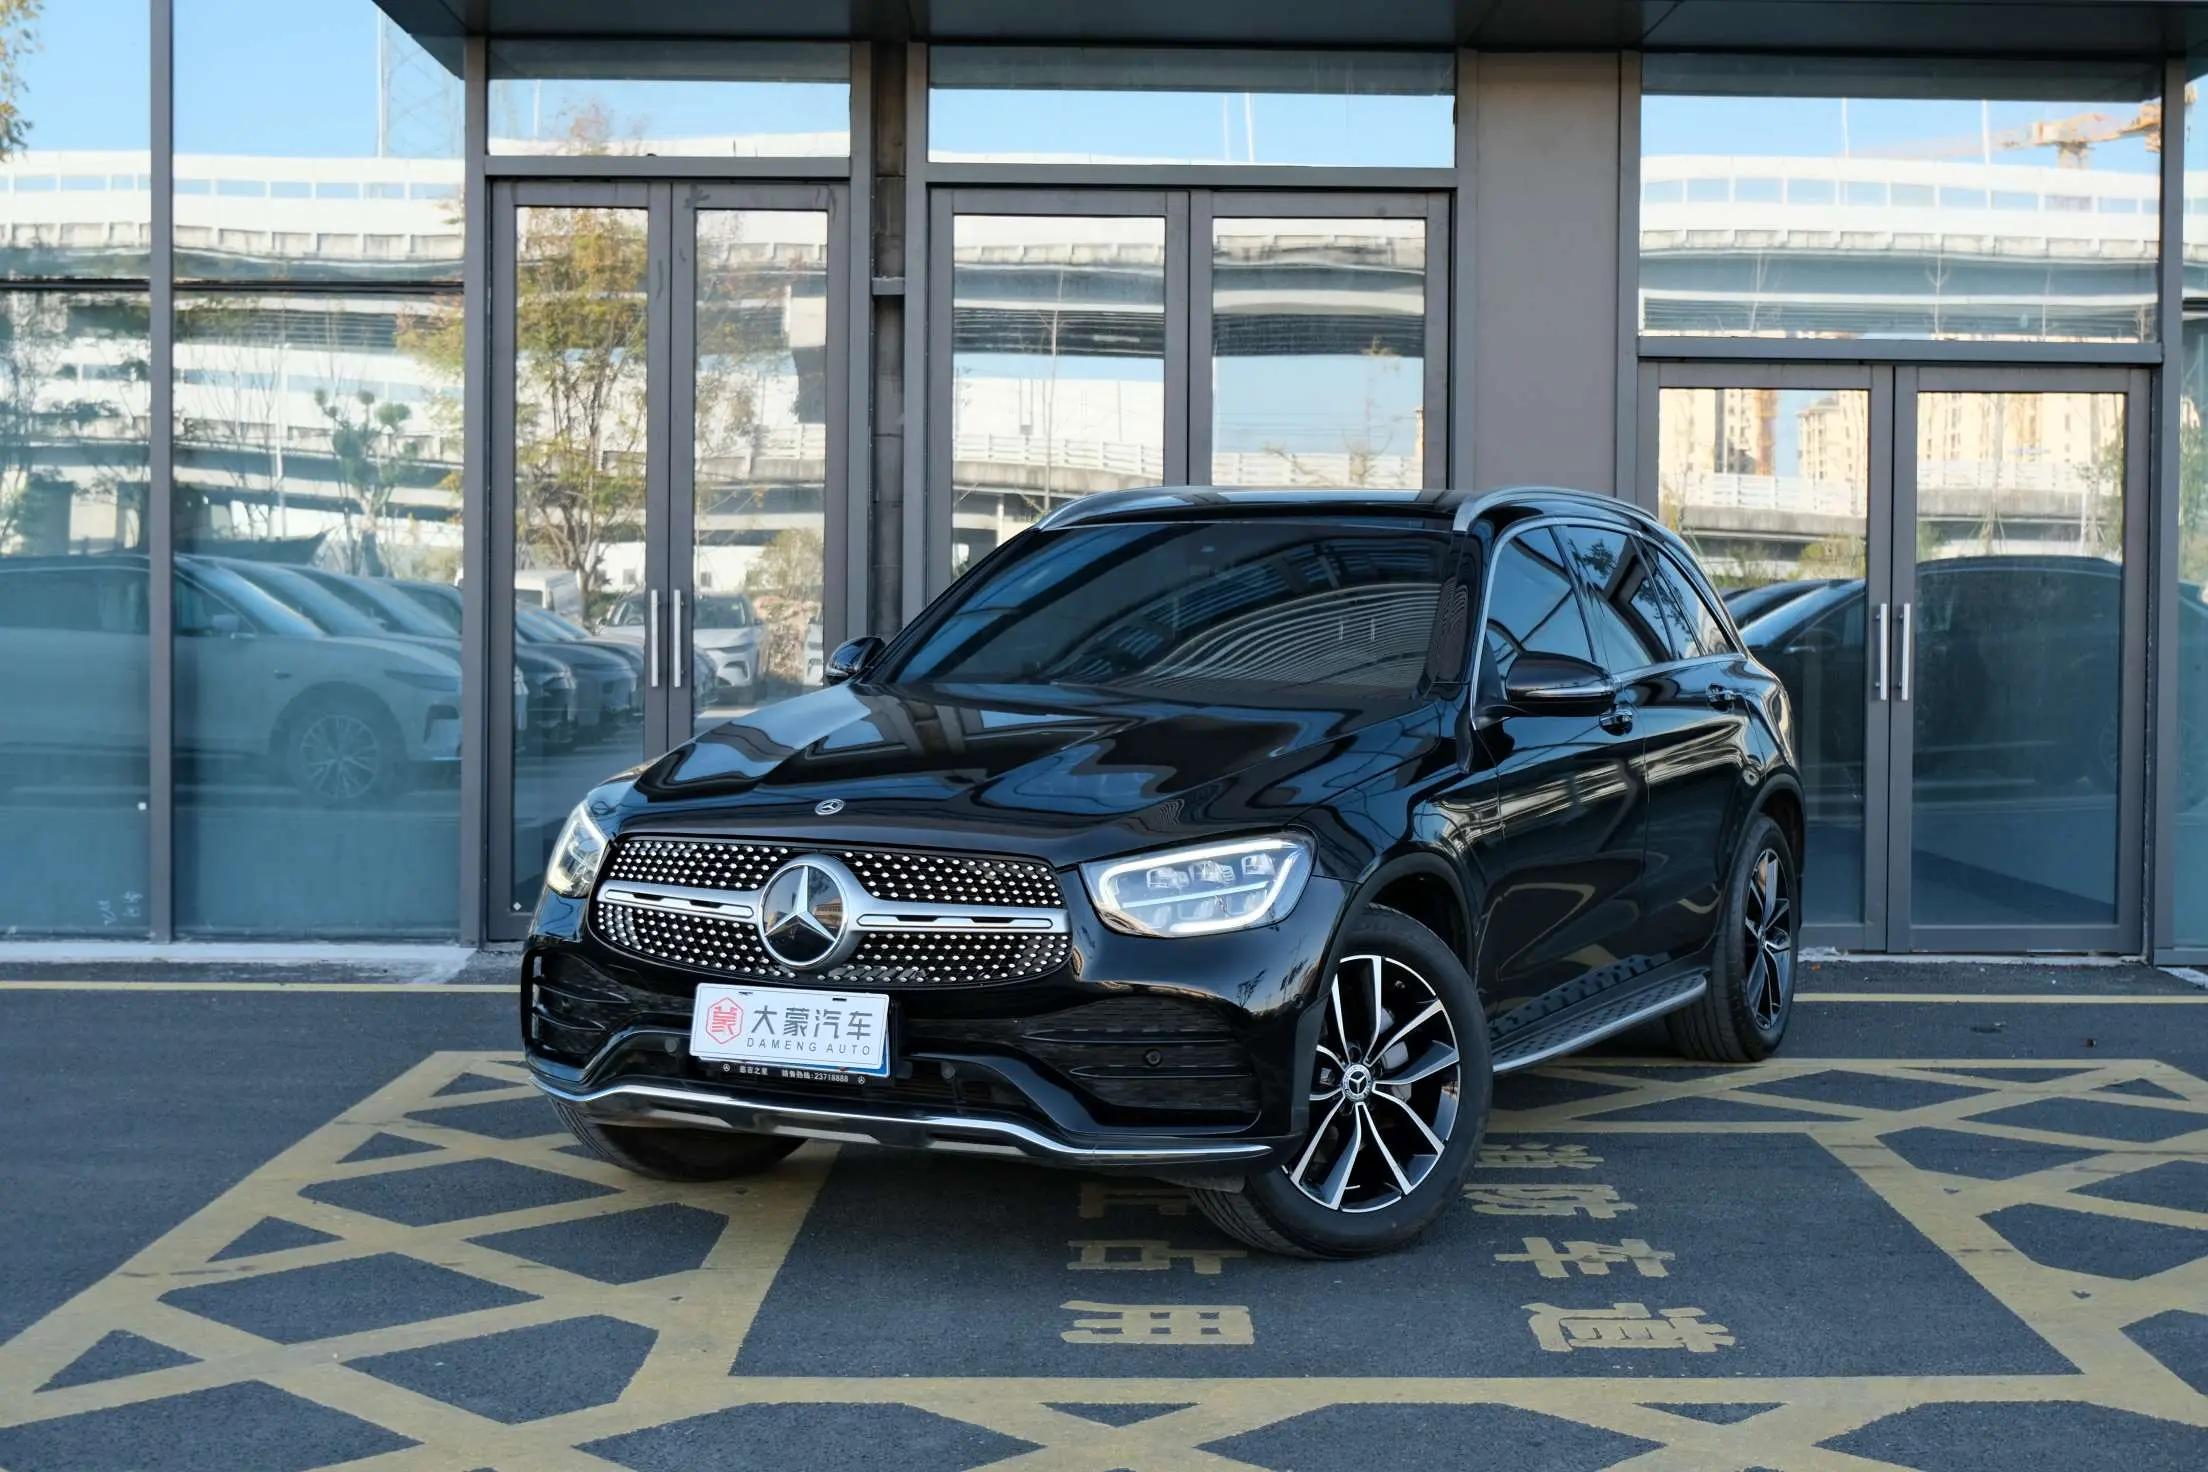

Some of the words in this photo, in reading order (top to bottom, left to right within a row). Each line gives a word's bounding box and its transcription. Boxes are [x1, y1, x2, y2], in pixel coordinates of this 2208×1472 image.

[750, 1005, 873, 1040] 大蒙汽车
[747, 1038, 818, 1052] DAMENG
[826, 1043, 870, 1056] AUTO
[1462, 1142, 1736, 1352] 消防车道
